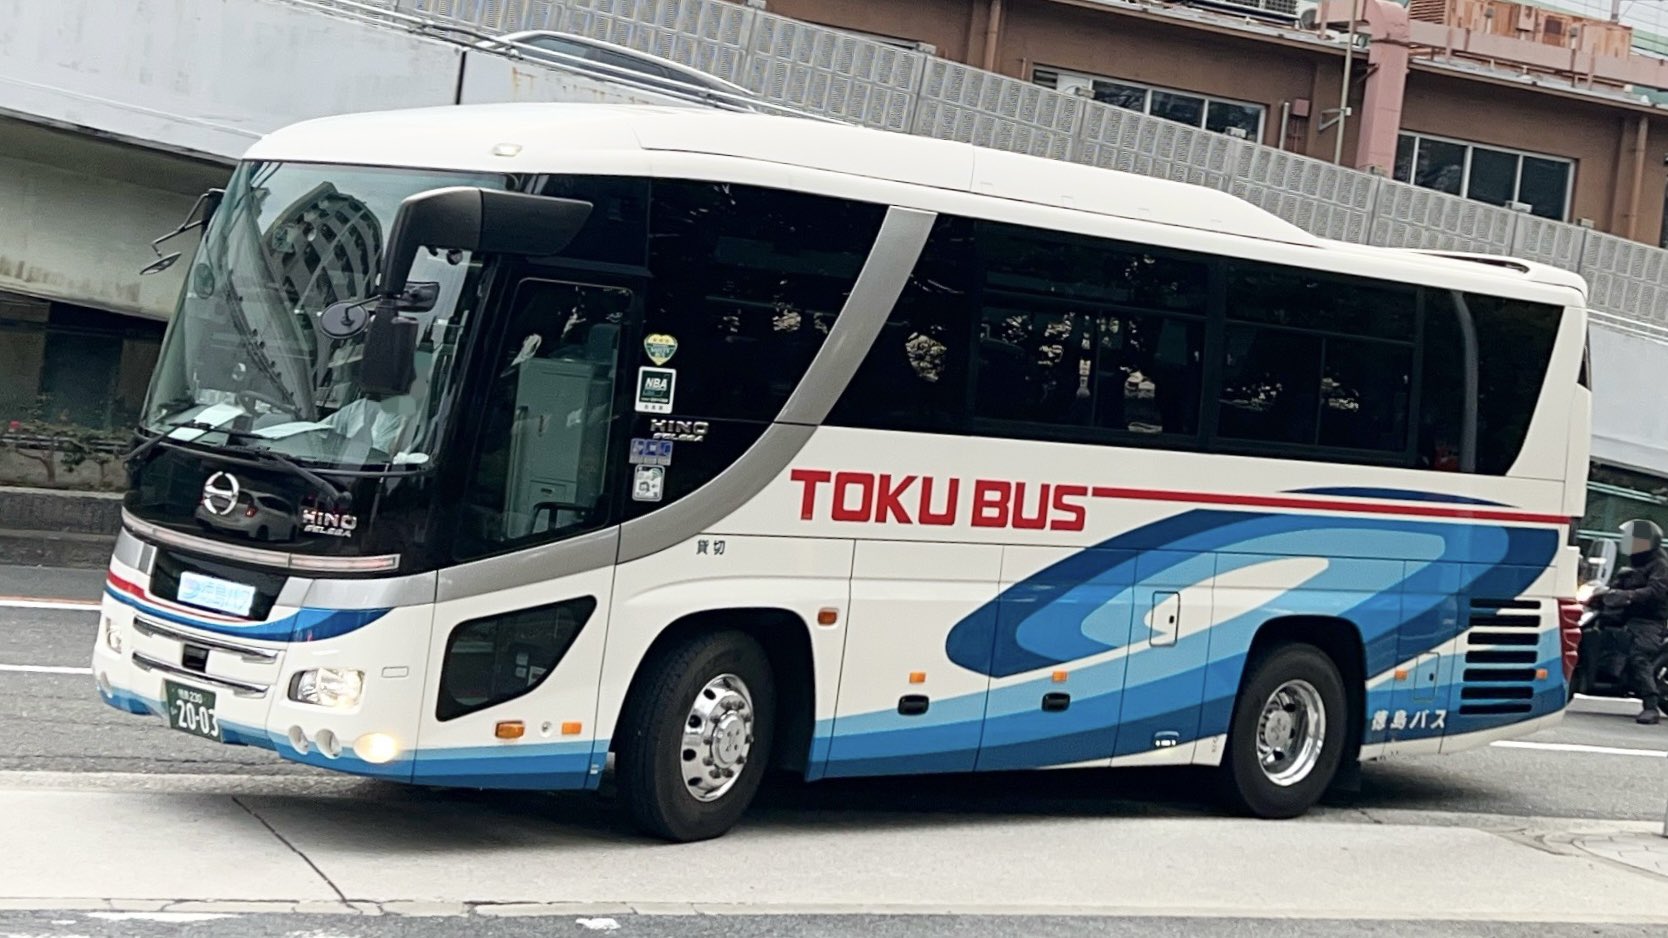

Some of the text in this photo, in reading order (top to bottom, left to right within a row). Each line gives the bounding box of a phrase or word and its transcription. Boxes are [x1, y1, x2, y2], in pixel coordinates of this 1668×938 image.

[644, 377, 668, 391] NBA
[650, 419, 709, 434] HINO
[791, 468, 1089, 532] TOKU BUS
[302, 509, 358, 530] HINO
[696, 539, 726, 556] 貸切
[176, 699, 219, 737] 20-03
